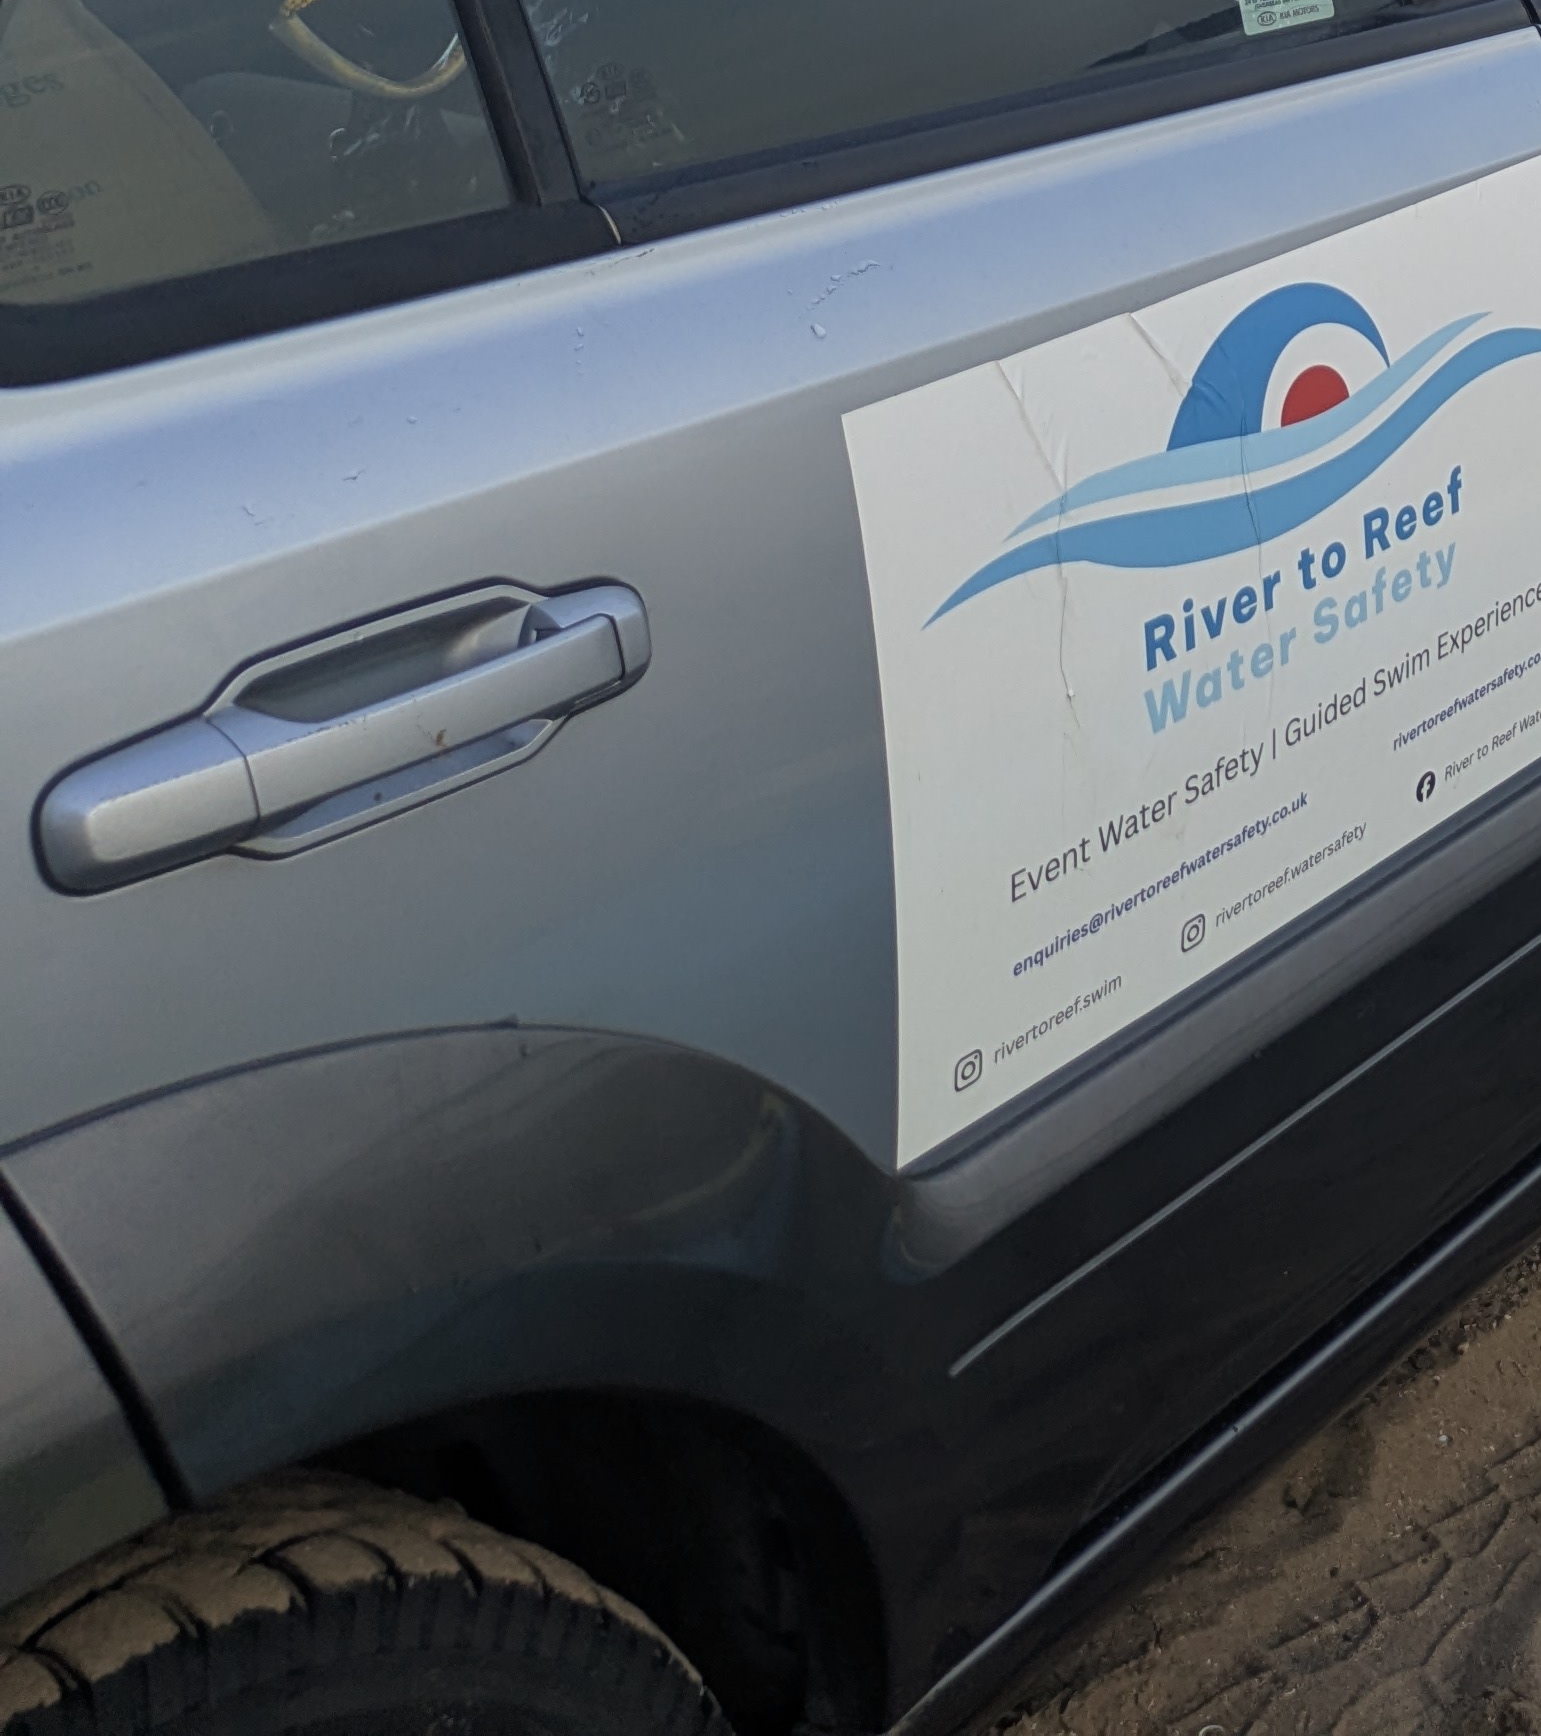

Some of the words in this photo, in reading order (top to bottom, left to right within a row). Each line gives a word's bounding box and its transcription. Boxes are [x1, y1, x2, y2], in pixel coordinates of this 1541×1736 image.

[1143, 569, 1282, 673] River
[1298, 541, 1347, 591] to
[1363, 464, 1463, 561] Reef
[1143, 626, 1298, 735] Water
[1312, 540, 1457, 645] Safety
[1010, 836, 1091, 904] Event
[1097, 790, 1178, 853] Water
[1184, 741, 1265, 805] Safety
[1284, 676, 1367, 747] Guided
[1372, 647, 1431, 697] Swim
[1443, 754, 1475, 782] River
[1476, 743, 1489, 761] to
[1491, 722, 1518, 752] Reef
[1012, 791, 1309, 978] enquiries@rivertoreefwatersafety.co.uk
[1215, 821, 1368, 929] rivertoreef.watersafety
[993, 974, 1123, 1064] rivertoreef.swim
